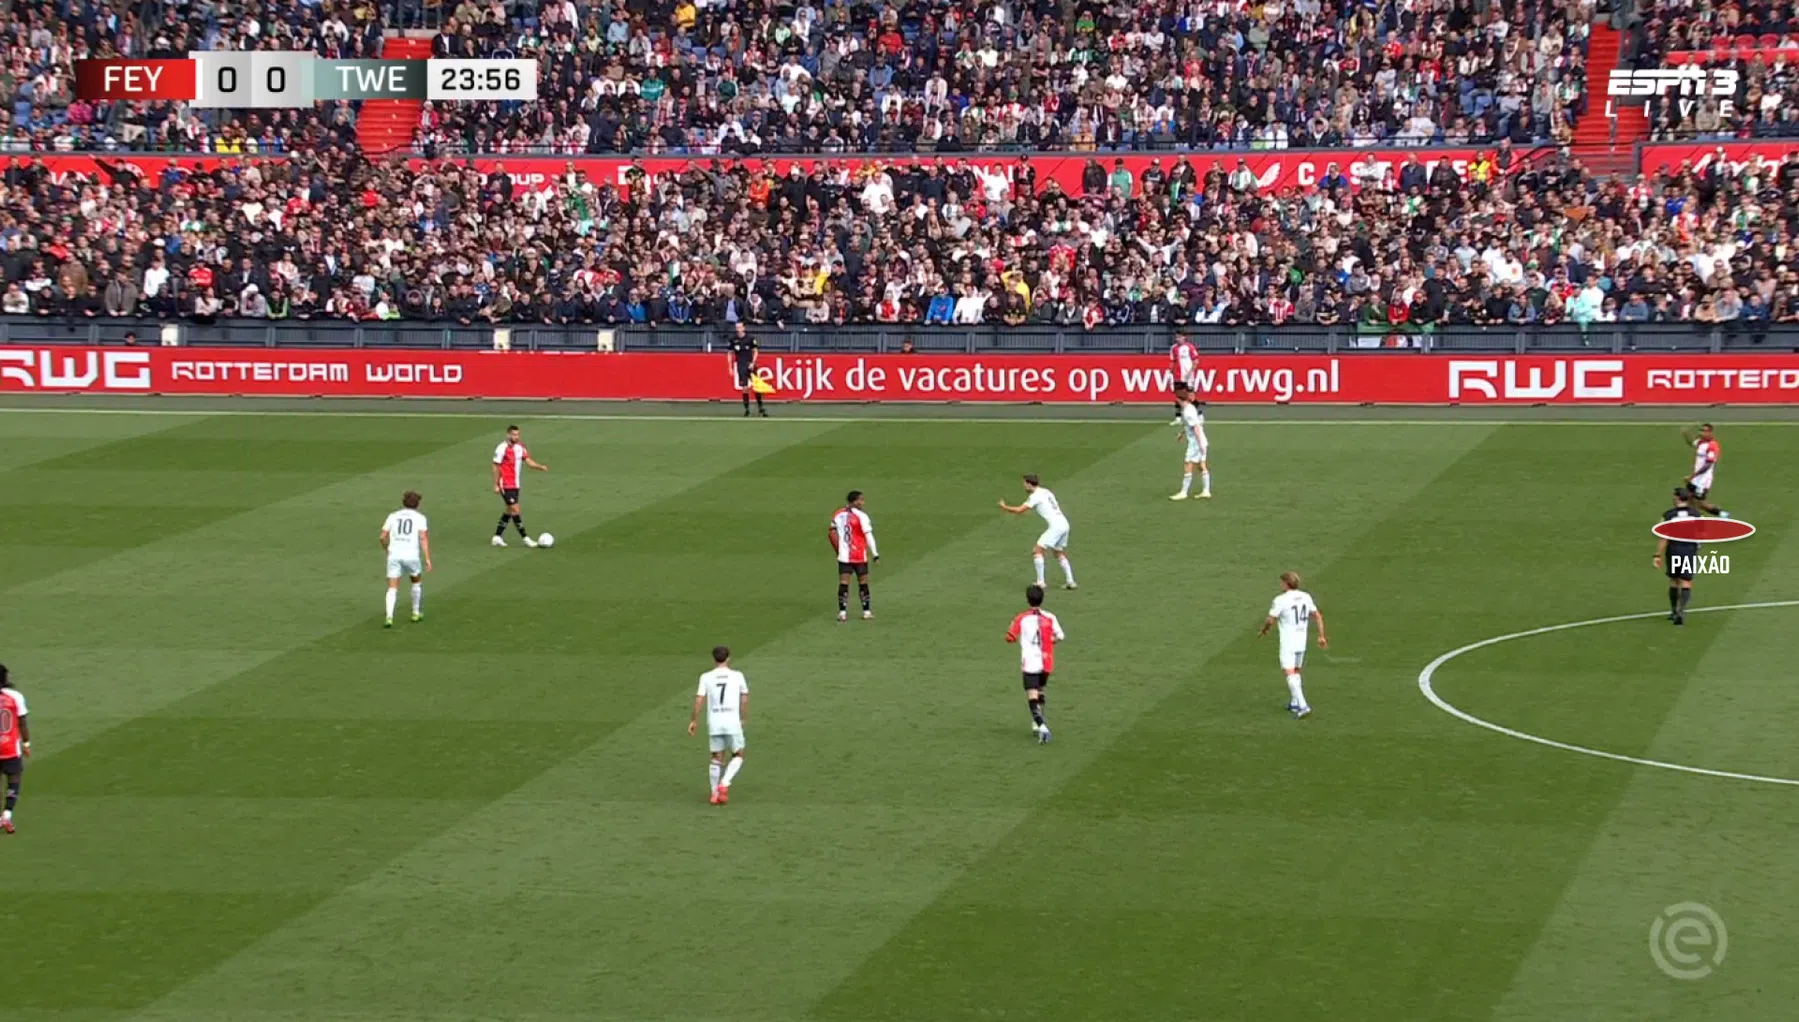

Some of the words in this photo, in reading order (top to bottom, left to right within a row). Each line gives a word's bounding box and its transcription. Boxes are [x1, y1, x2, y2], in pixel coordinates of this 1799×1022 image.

[171, 361, 349, 382] ROTTERDAM
[366, 364, 462, 383] WORLD
[845, 358, 887, 391] de
[898, 363, 1056, 392] vacatures
[1068, 368, 1109, 400] op
[1449, 361, 1624, 398] RWG
[396, 518, 413, 535] 10
[843, 525, 852, 543] 8
[1291, 604, 1308, 625] 14
[1031, 629, 1042, 646] 4
[716, 683, 727, 705] 7
